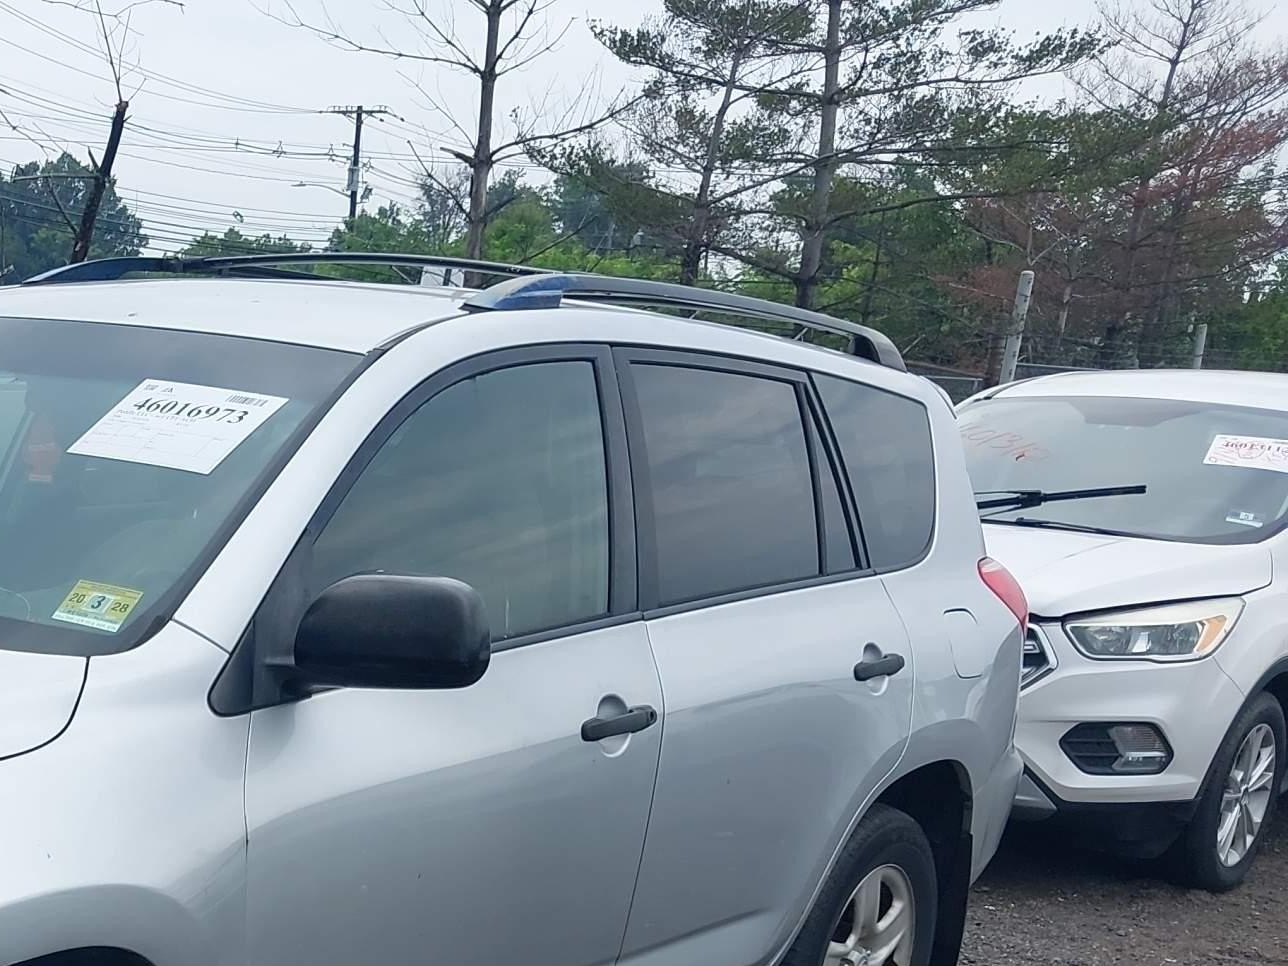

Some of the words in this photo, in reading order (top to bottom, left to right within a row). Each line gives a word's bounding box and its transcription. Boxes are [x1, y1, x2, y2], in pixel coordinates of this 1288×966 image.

[133, 397, 250, 425] 46016973
[68, 592, 86, 605] 20
[91, 595, 106, 609] 3
[111, 601, 130, 614] 28
